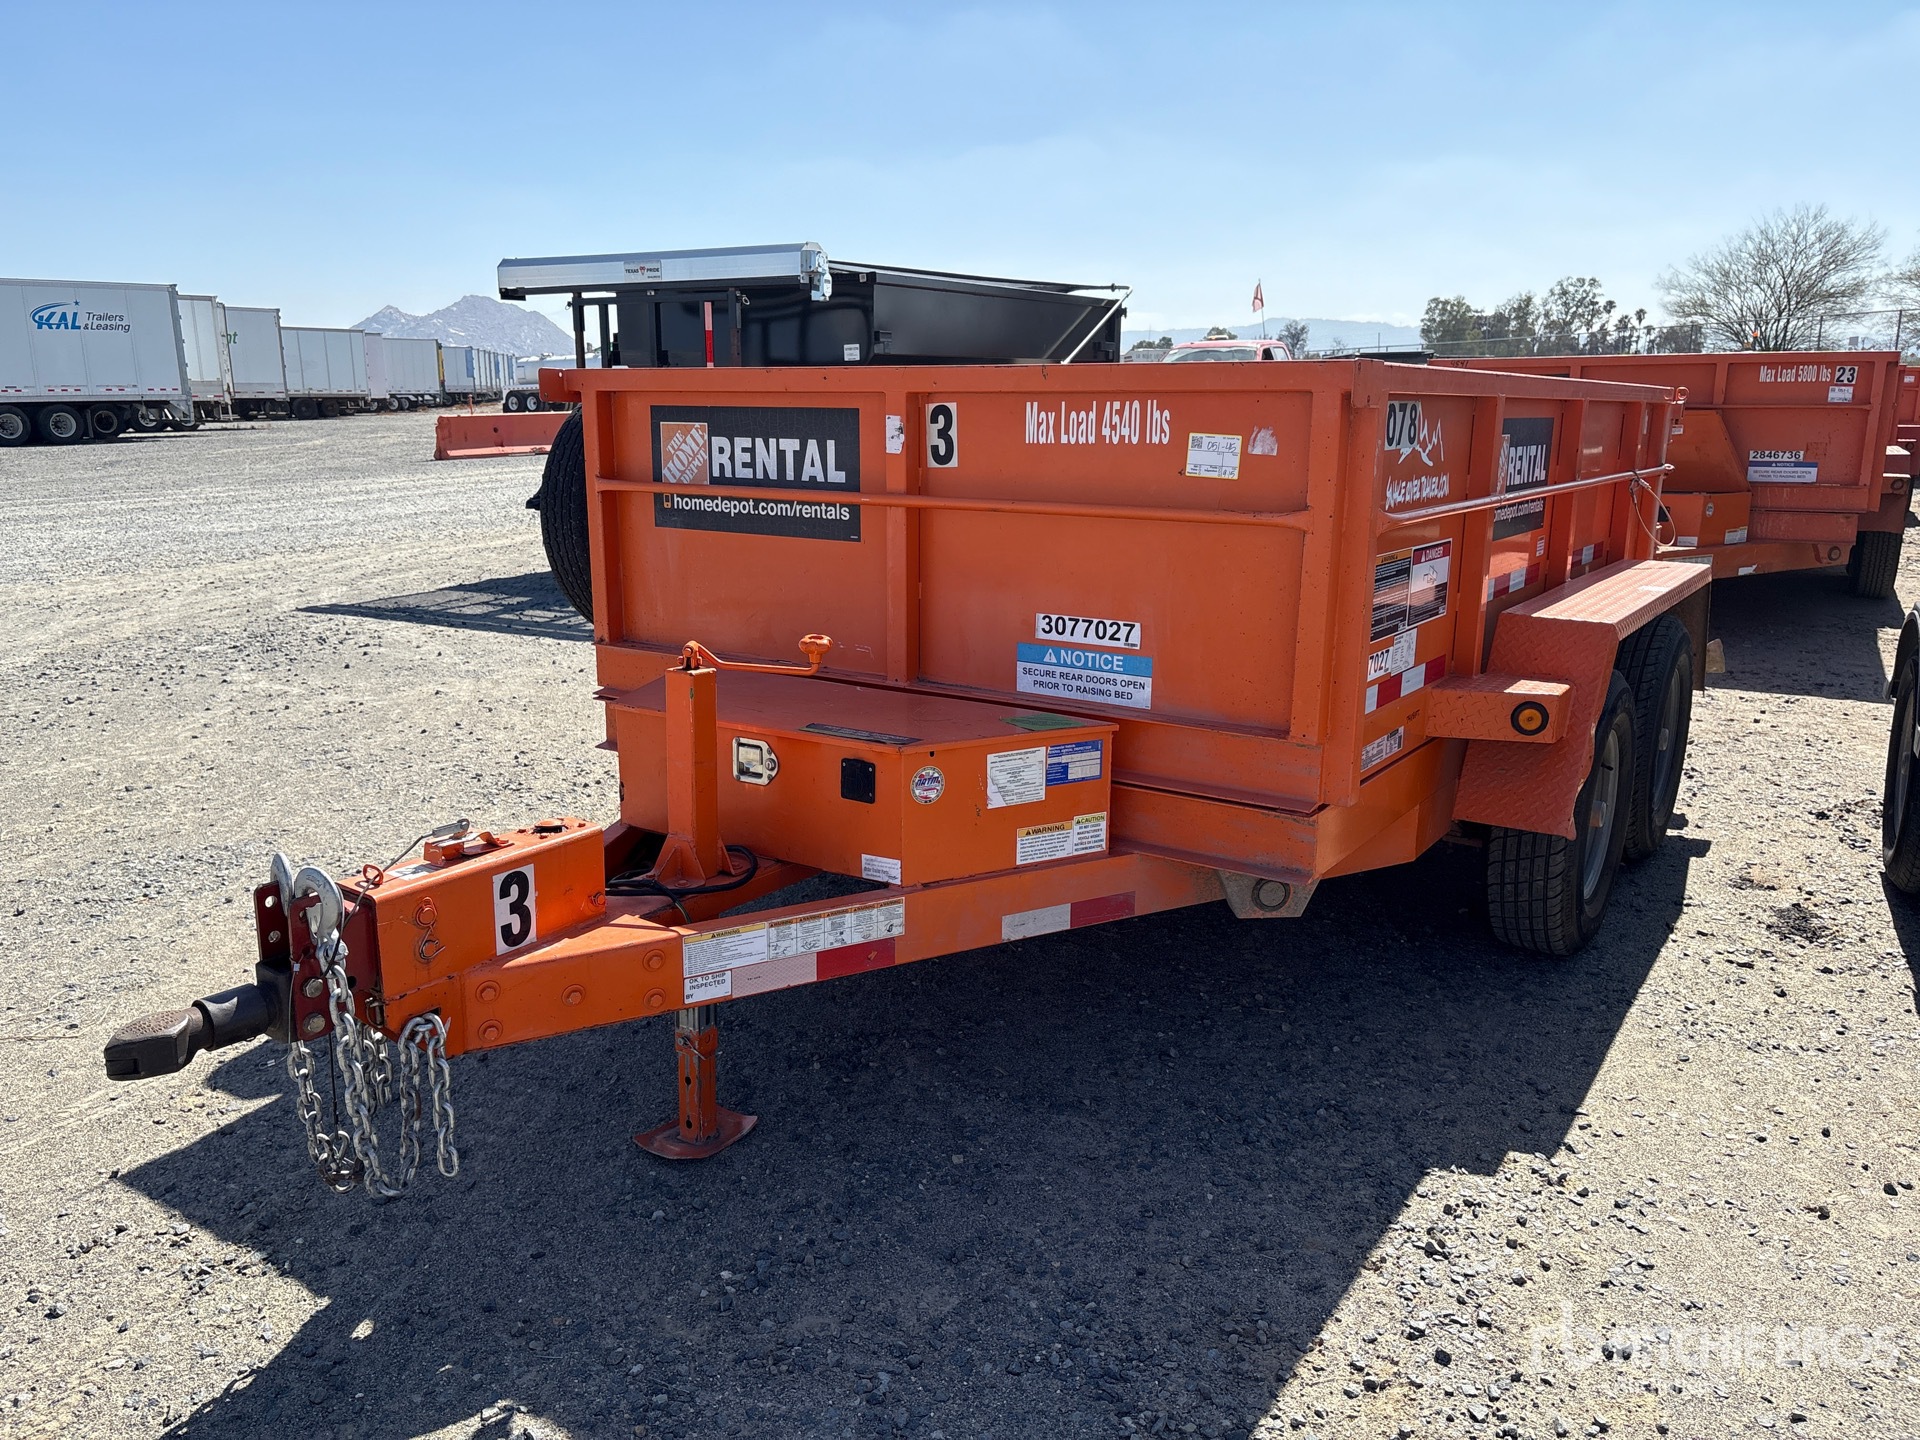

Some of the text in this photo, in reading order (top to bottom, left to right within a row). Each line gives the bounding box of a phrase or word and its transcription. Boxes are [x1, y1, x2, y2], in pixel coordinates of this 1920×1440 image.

[36, 311, 81, 330] KAL
[85, 311, 124, 322] Trailers
[1759, 365, 1831, 382] Max Load 5800 lbs
[1836, 367, 1856, 383] 23
[1025, 400, 1170, 444] Max Load 4540 lbs
[666, 430, 685, 454] THE
[930, 404, 955, 466] 3
[663, 423, 708, 483] HOME
[711, 436, 846, 483] RENTAL
[1752, 451, 1800, 459] 2846736
[680, 447, 708, 484] DEPOT
[1507, 444, 1547, 486] RENTAL
[673, 493, 850, 521] homedepot.com/rentals
[1426, 547, 1443, 560] DANGER
[1041, 615, 1136, 642] 3077027
[1060, 650, 1124, 671] NOTICE
[1023, 667, 1145, 690] SECURE REAR DOORS OPEN
[1033, 680, 1133, 700] PRIOR TO RAISING BED
[1032, 824, 1065, 835] WARNING
[499, 870, 532, 948] 3
[716, 928, 740, 937] WARNING
[689, 979, 726, 991] INSPECTED
[711, 972, 726, 981] SHIP
